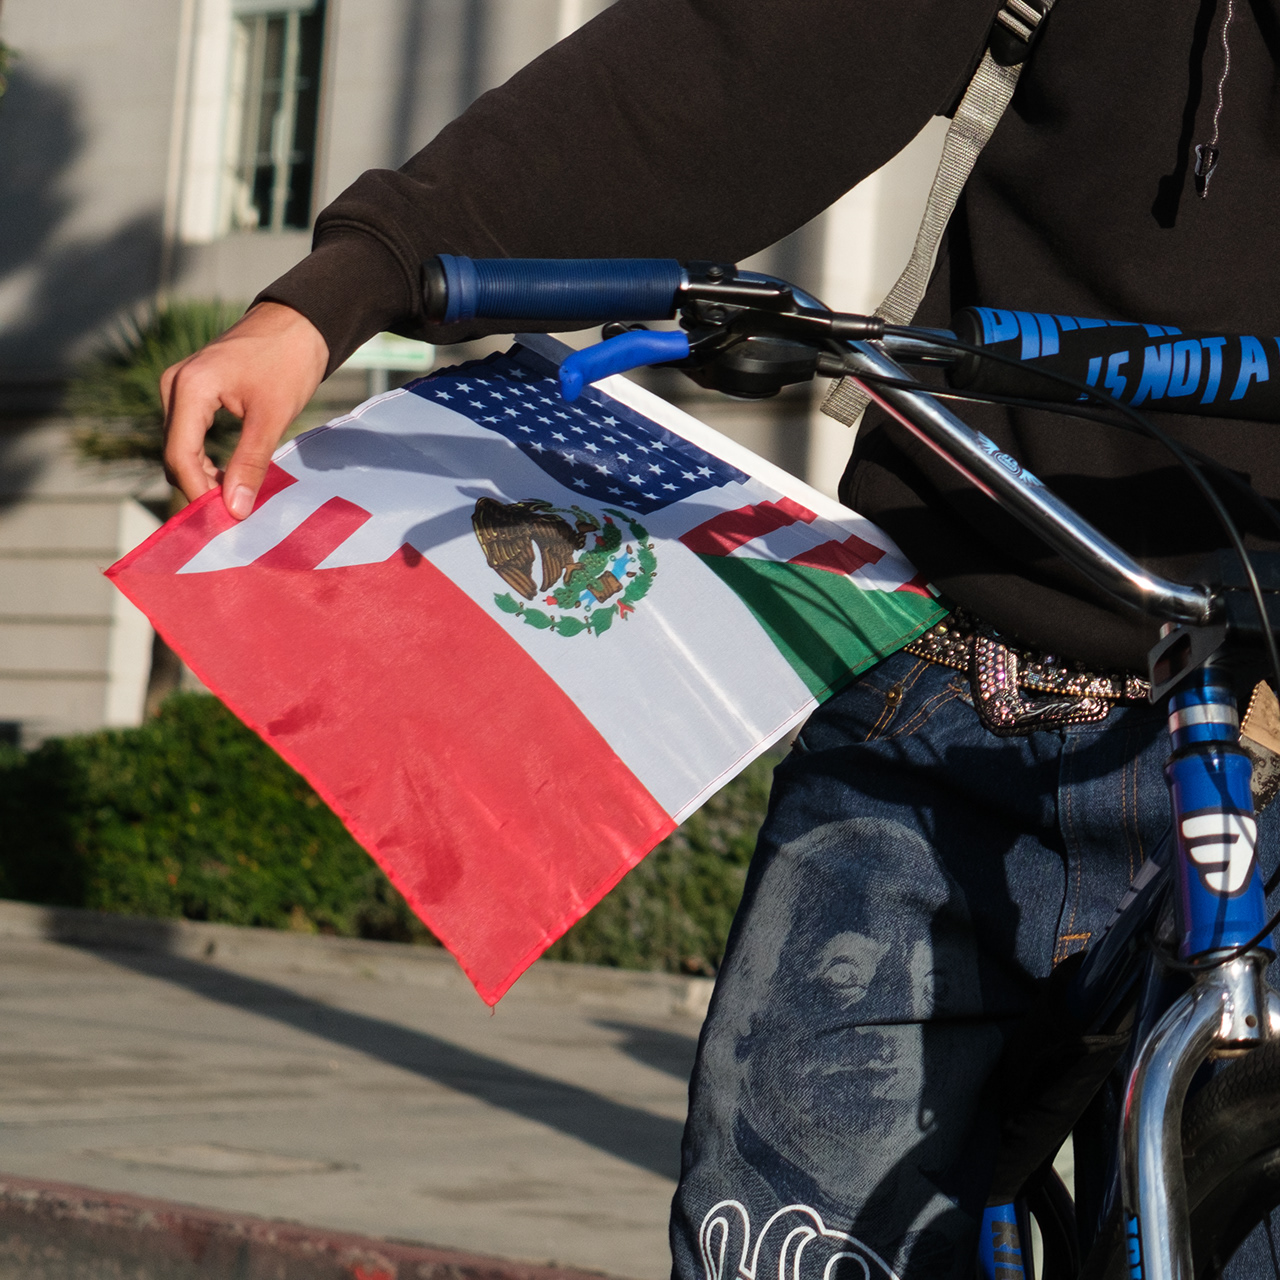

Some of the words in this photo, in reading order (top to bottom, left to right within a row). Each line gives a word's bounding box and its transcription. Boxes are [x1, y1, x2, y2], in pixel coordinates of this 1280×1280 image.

[1077, 350, 1130, 401] IS
[1129, 336, 1228, 406] NOT
[1230, 336, 1269, 401] A
